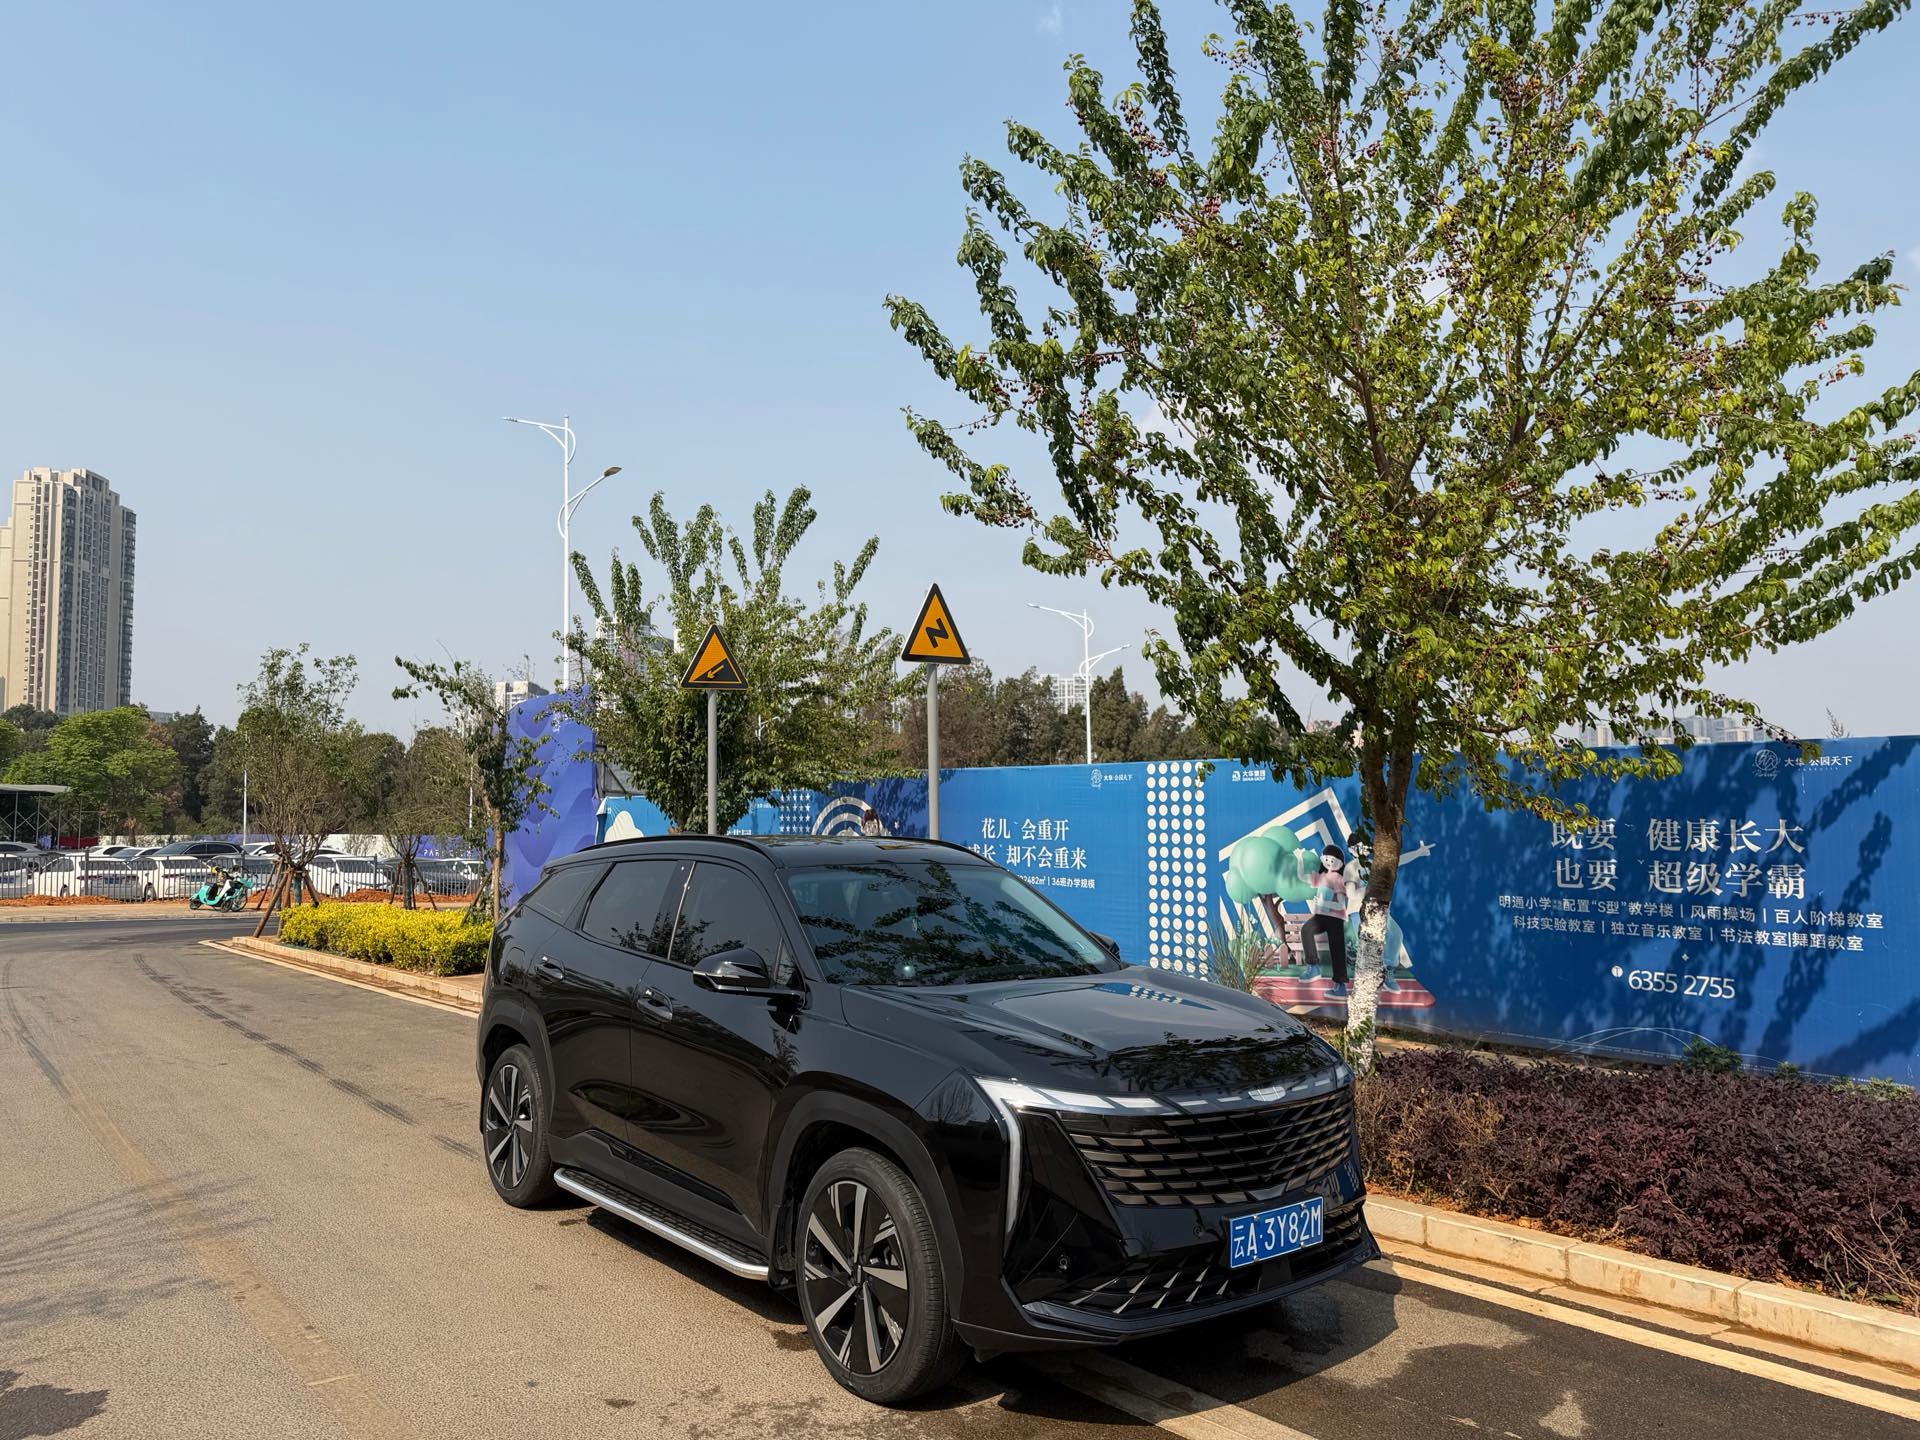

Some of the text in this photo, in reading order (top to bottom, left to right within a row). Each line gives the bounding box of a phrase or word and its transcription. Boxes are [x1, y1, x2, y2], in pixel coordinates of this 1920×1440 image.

[981, 817, 1070, 841] 花儿 会重开
[1551, 818, 1806, 854] 既要 健康长大
[1006, 845, 1088, 870] 却不会重来
[1552, 857, 1806, 900] 也要 超级学霸
[1513, 915, 1596, 934] 科技实验教室
[1611, 921, 1703, 941] 独立音乐教室
[1690, 904, 1756, 923] 风雨操场
[1774, 908, 1884, 929] 百人阶梯教室
[1628, 970, 1736, 999] 6355 2755
